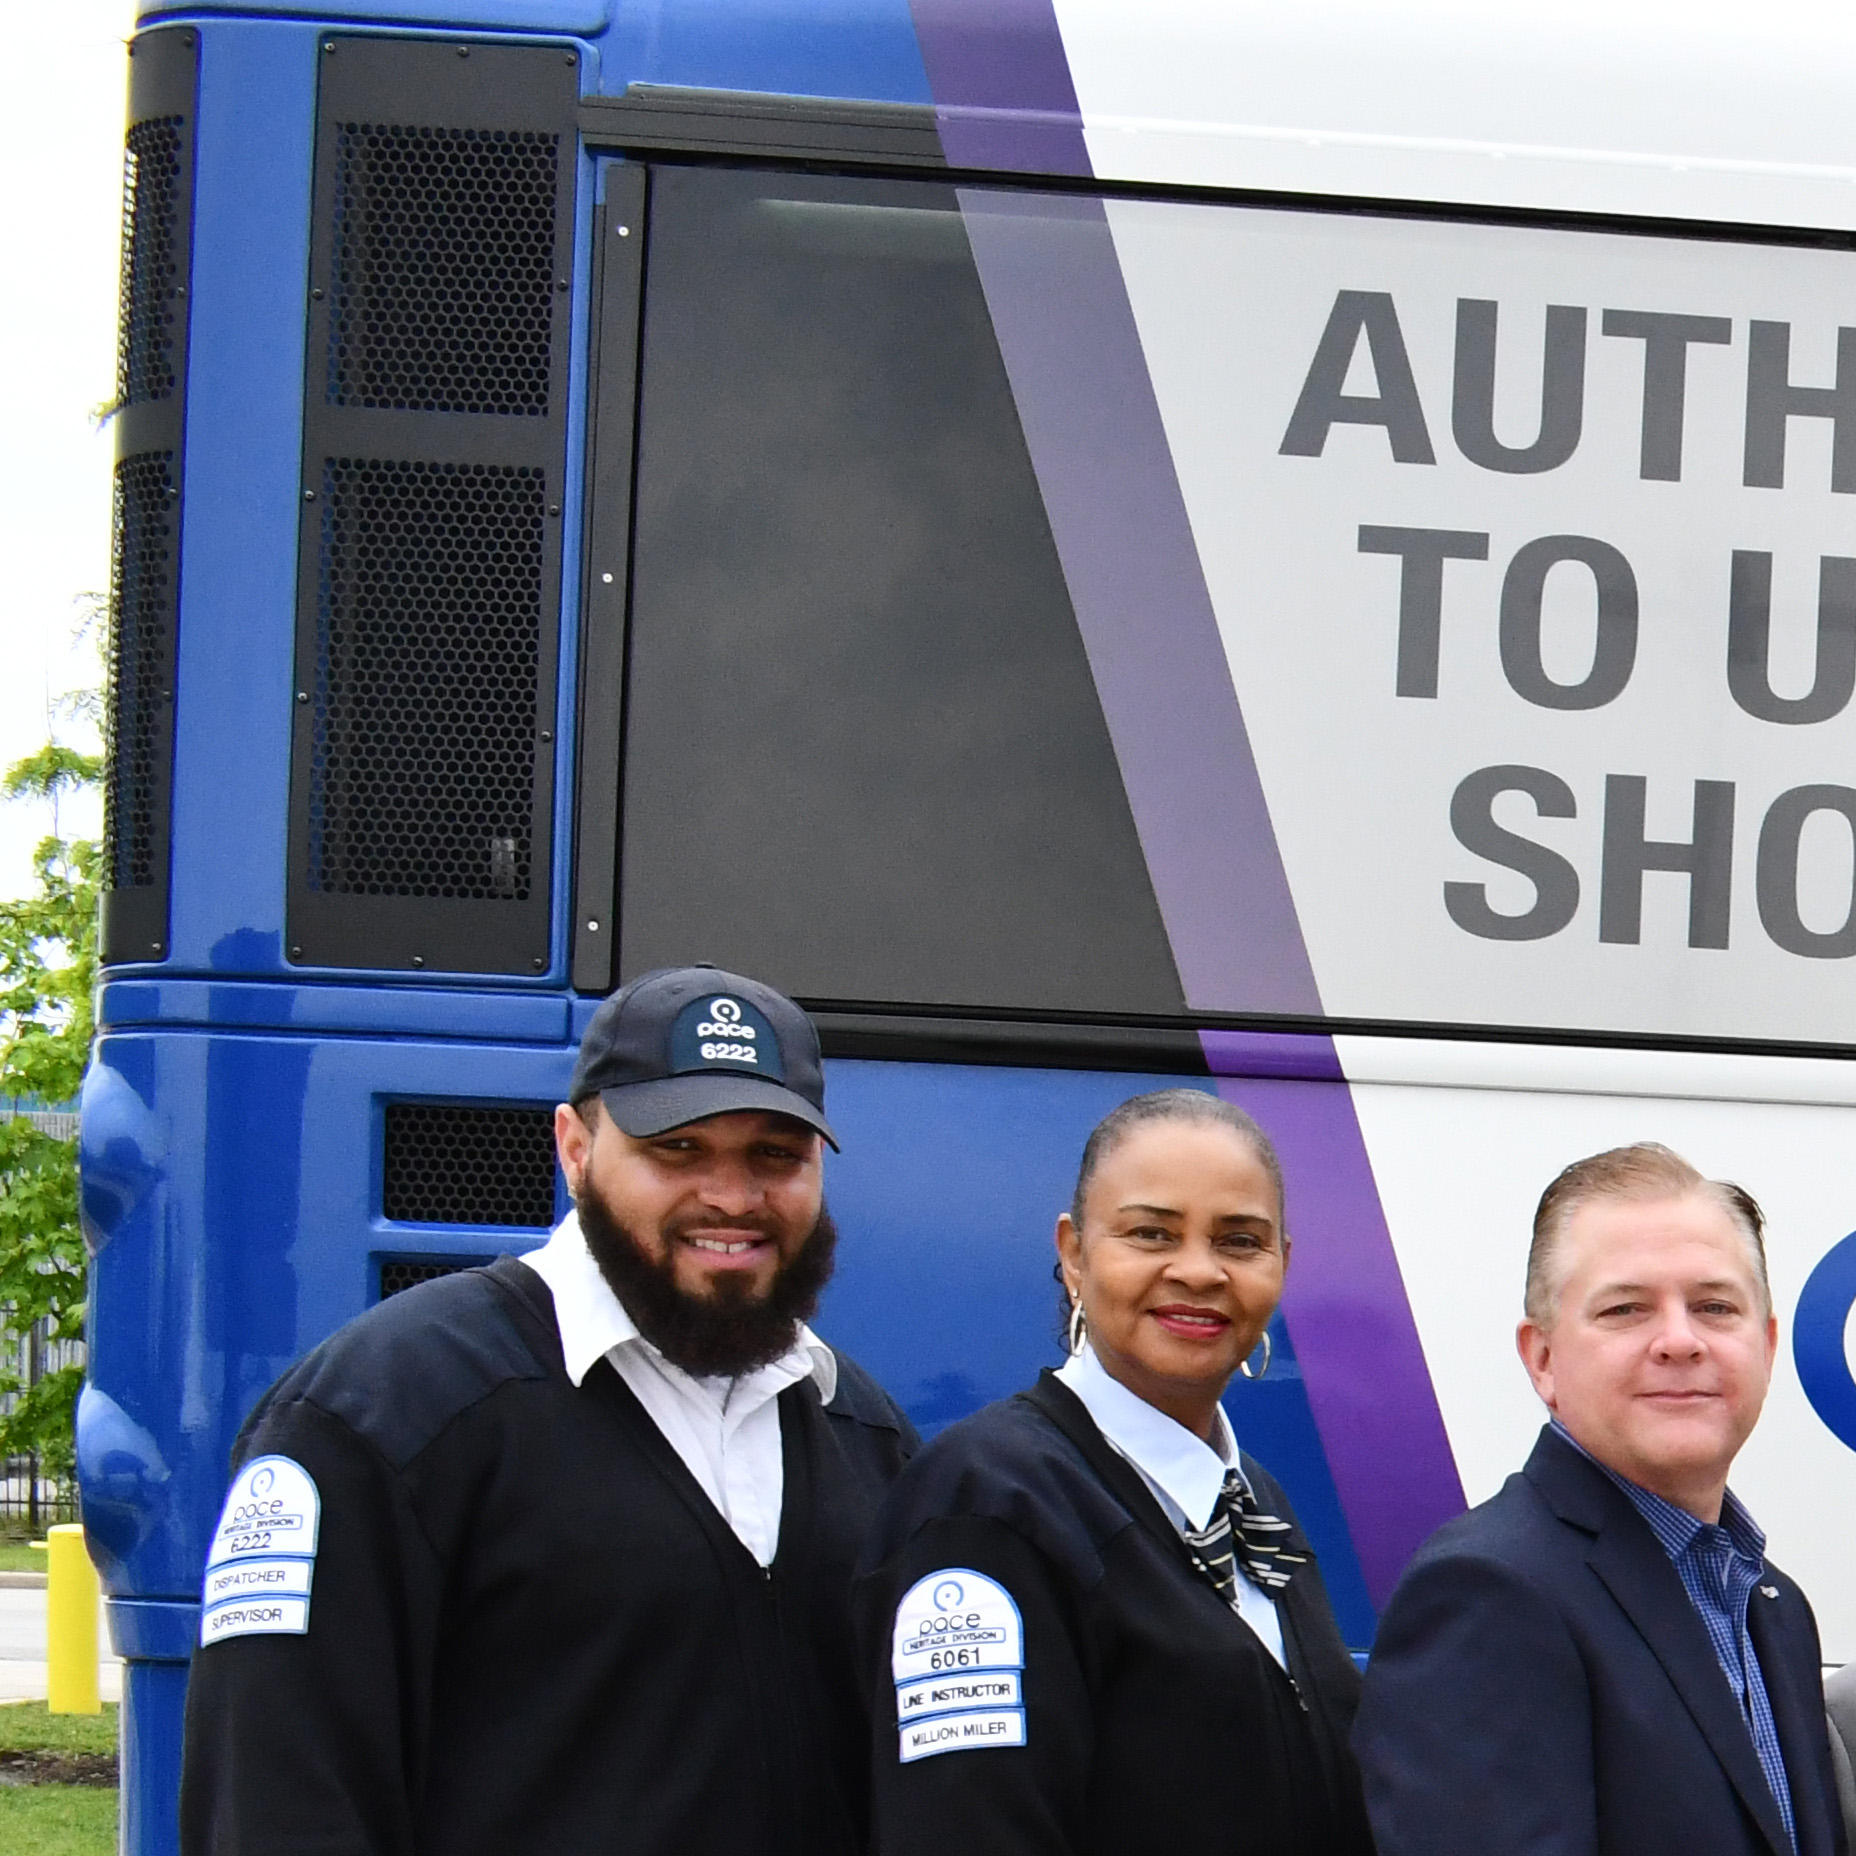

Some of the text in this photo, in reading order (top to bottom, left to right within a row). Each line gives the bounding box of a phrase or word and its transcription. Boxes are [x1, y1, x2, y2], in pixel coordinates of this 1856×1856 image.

[1357, 524, 1640, 711] TO
[697, 1022, 756, 1039] pace
[701, 1042, 758, 1063] 6222
[234, 1499, 283, 1523] pace
[231, 1533, 271, 1553] 6222
[214, 1571, 286, 1591] DISPATCHER
[212, 1608, 282, 1630] SUPERVISOR
[919, 1613, 981, 1638] pace
[952, 1632, 997, 1642] DIVISION
[931, 1647, 980, 1669] 6061
[903, 1683, 1011, 1709] LINE INSTRUCTOR
[912, 1722, 1007, 1746] MILLION MILER
